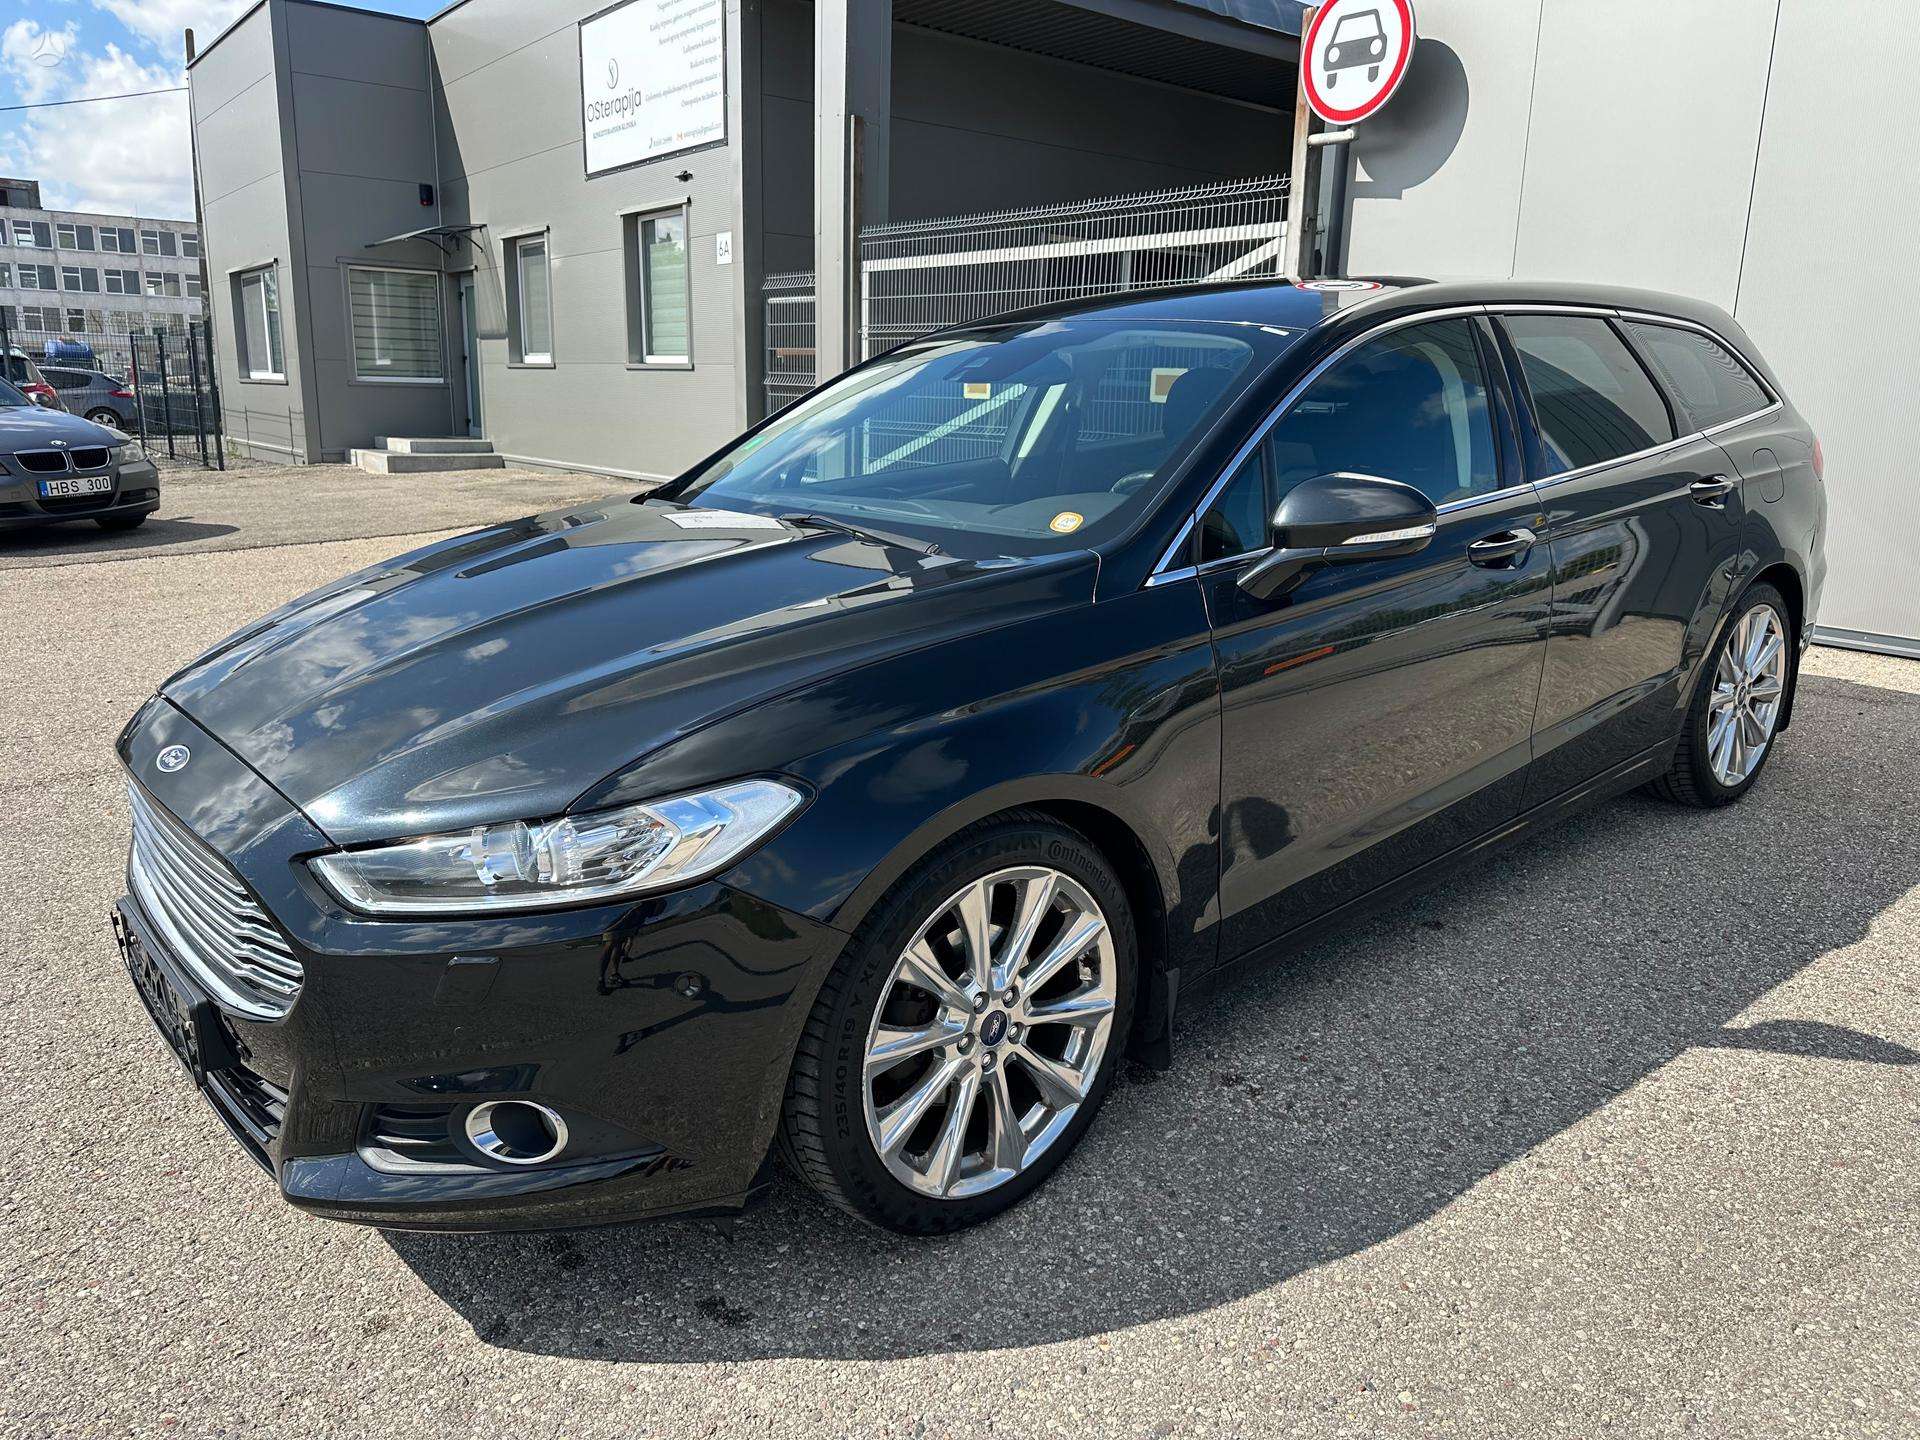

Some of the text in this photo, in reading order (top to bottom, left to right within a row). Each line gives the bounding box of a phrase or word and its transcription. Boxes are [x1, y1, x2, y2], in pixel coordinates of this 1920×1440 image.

[718, 240, 729, 257] 6A
[49, 480, 80, 495] HBS
[87, 477, 109, 491] 300
[1047, 839, 1111, 891] Continental
[859, 958, 881, 986] XL
[843, 1017, 857, 1040] 19
[837, 1047, 850, 1061] R
[833, 1065, 850, 1139] 235/40
